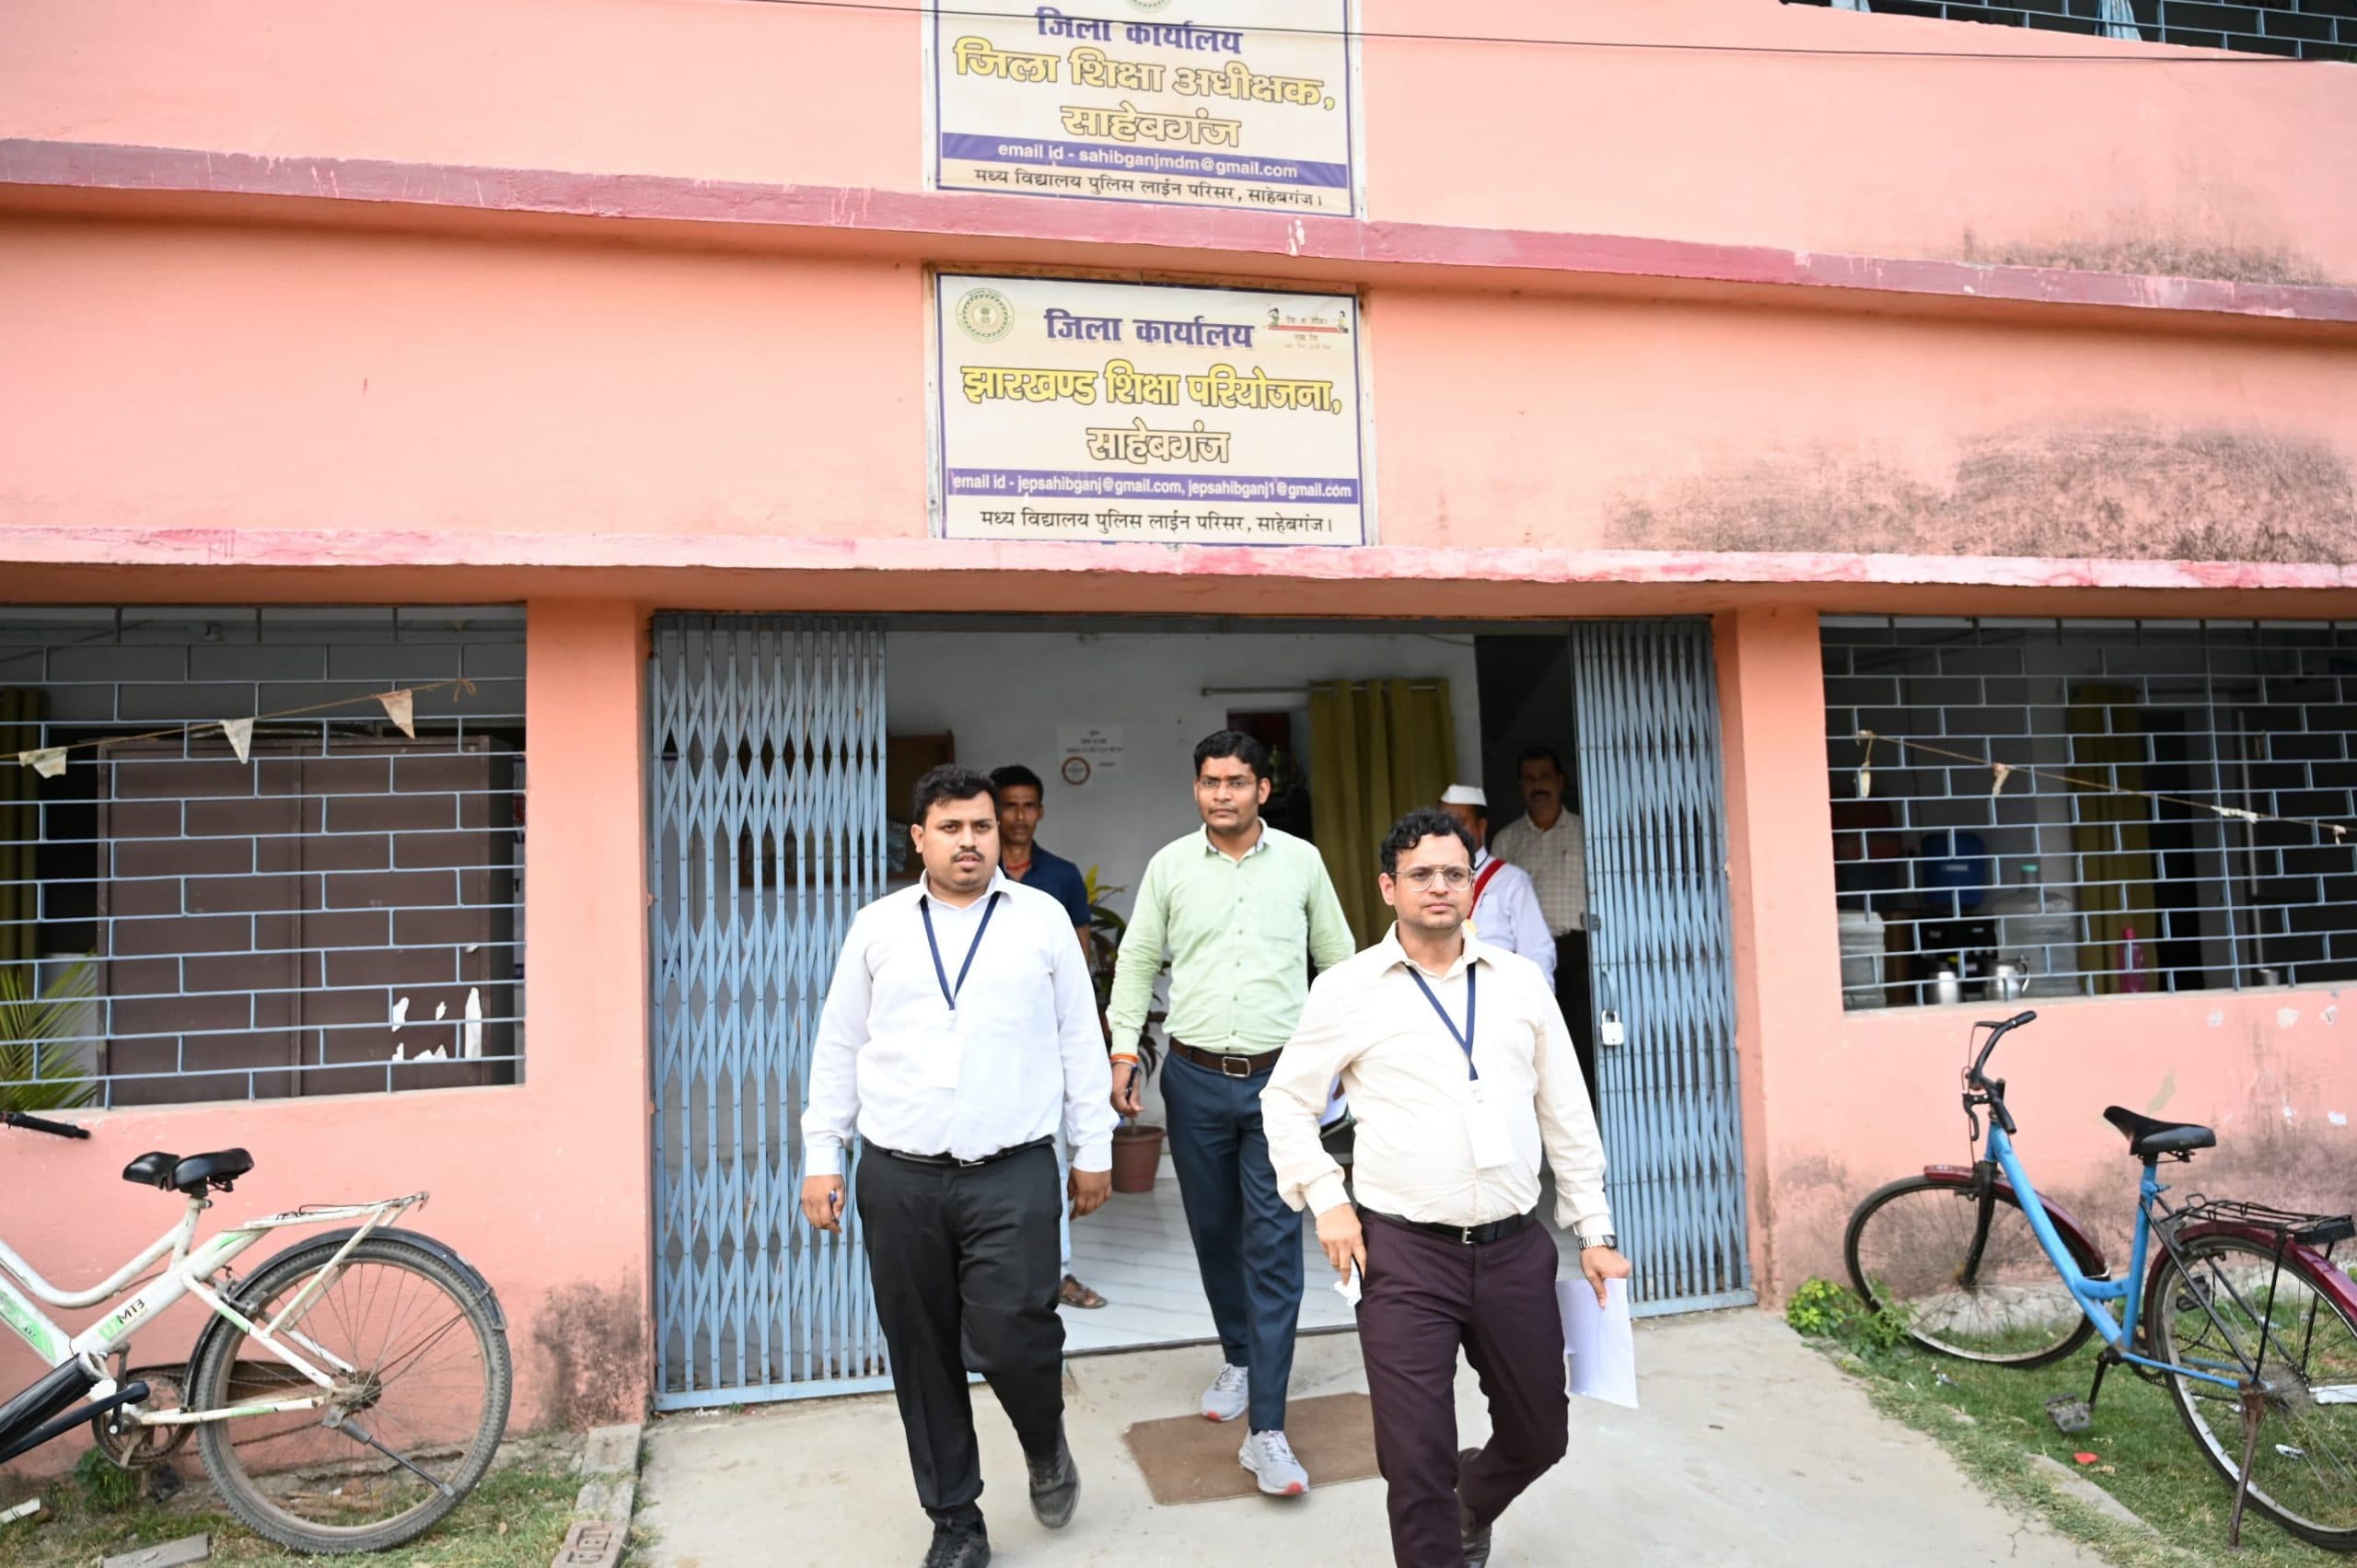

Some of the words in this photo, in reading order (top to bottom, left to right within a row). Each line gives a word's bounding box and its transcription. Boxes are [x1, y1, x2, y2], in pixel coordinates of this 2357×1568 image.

[1035, 6, 1112, 41] जिला
[1124, 21, 1244, 54] कार्यालय
[953, 36, 1061, 83] जिला
[1068, 46, 1166, 92] शिक्षा
[1172, 61, 1335, 110] अधीक्षक,
[1060, 100, 1242, 147] साहेबगंज
[974, 168, 1009, 182] मध्य
[1014, 168, 1082, 188] विद्यालय
[1087, 174, 1134, 194] पुलिस
[1140, 178, 1181, 196] लाईन
[998, 144, 1043, 159] email
[1049, 145, 1064, 160] id
[1079, 148, 1297, 178] sahibganjmdm@gmail.com
[1043, 308, 1123, 342] जिला
[1132, 316, 1255, 348] कार्यालय
[960, 366, 1098, 406] झारखण्ड
[1104, 358, 1180, 405] शिक्षा
[1186, 364, 1342, 414] परियोजना,
[1086, 417, 1231, 464] साहेबगंज
[952, 474, 990, 490] email
[993, 474, 1006, 489] id
[1017, 475, 1185, 495] jepsahibganj@gmail.com,
[1188, 480, 1352, 500] jepsahibganj1@gmail.com
[980, 511, 1015, 526] मध्य
[1021, 507, 1089, 528] विद्यालय
[1095, 509, 1142, 534] पुलिस
[1148, 509, 1190, 532] लाईन
